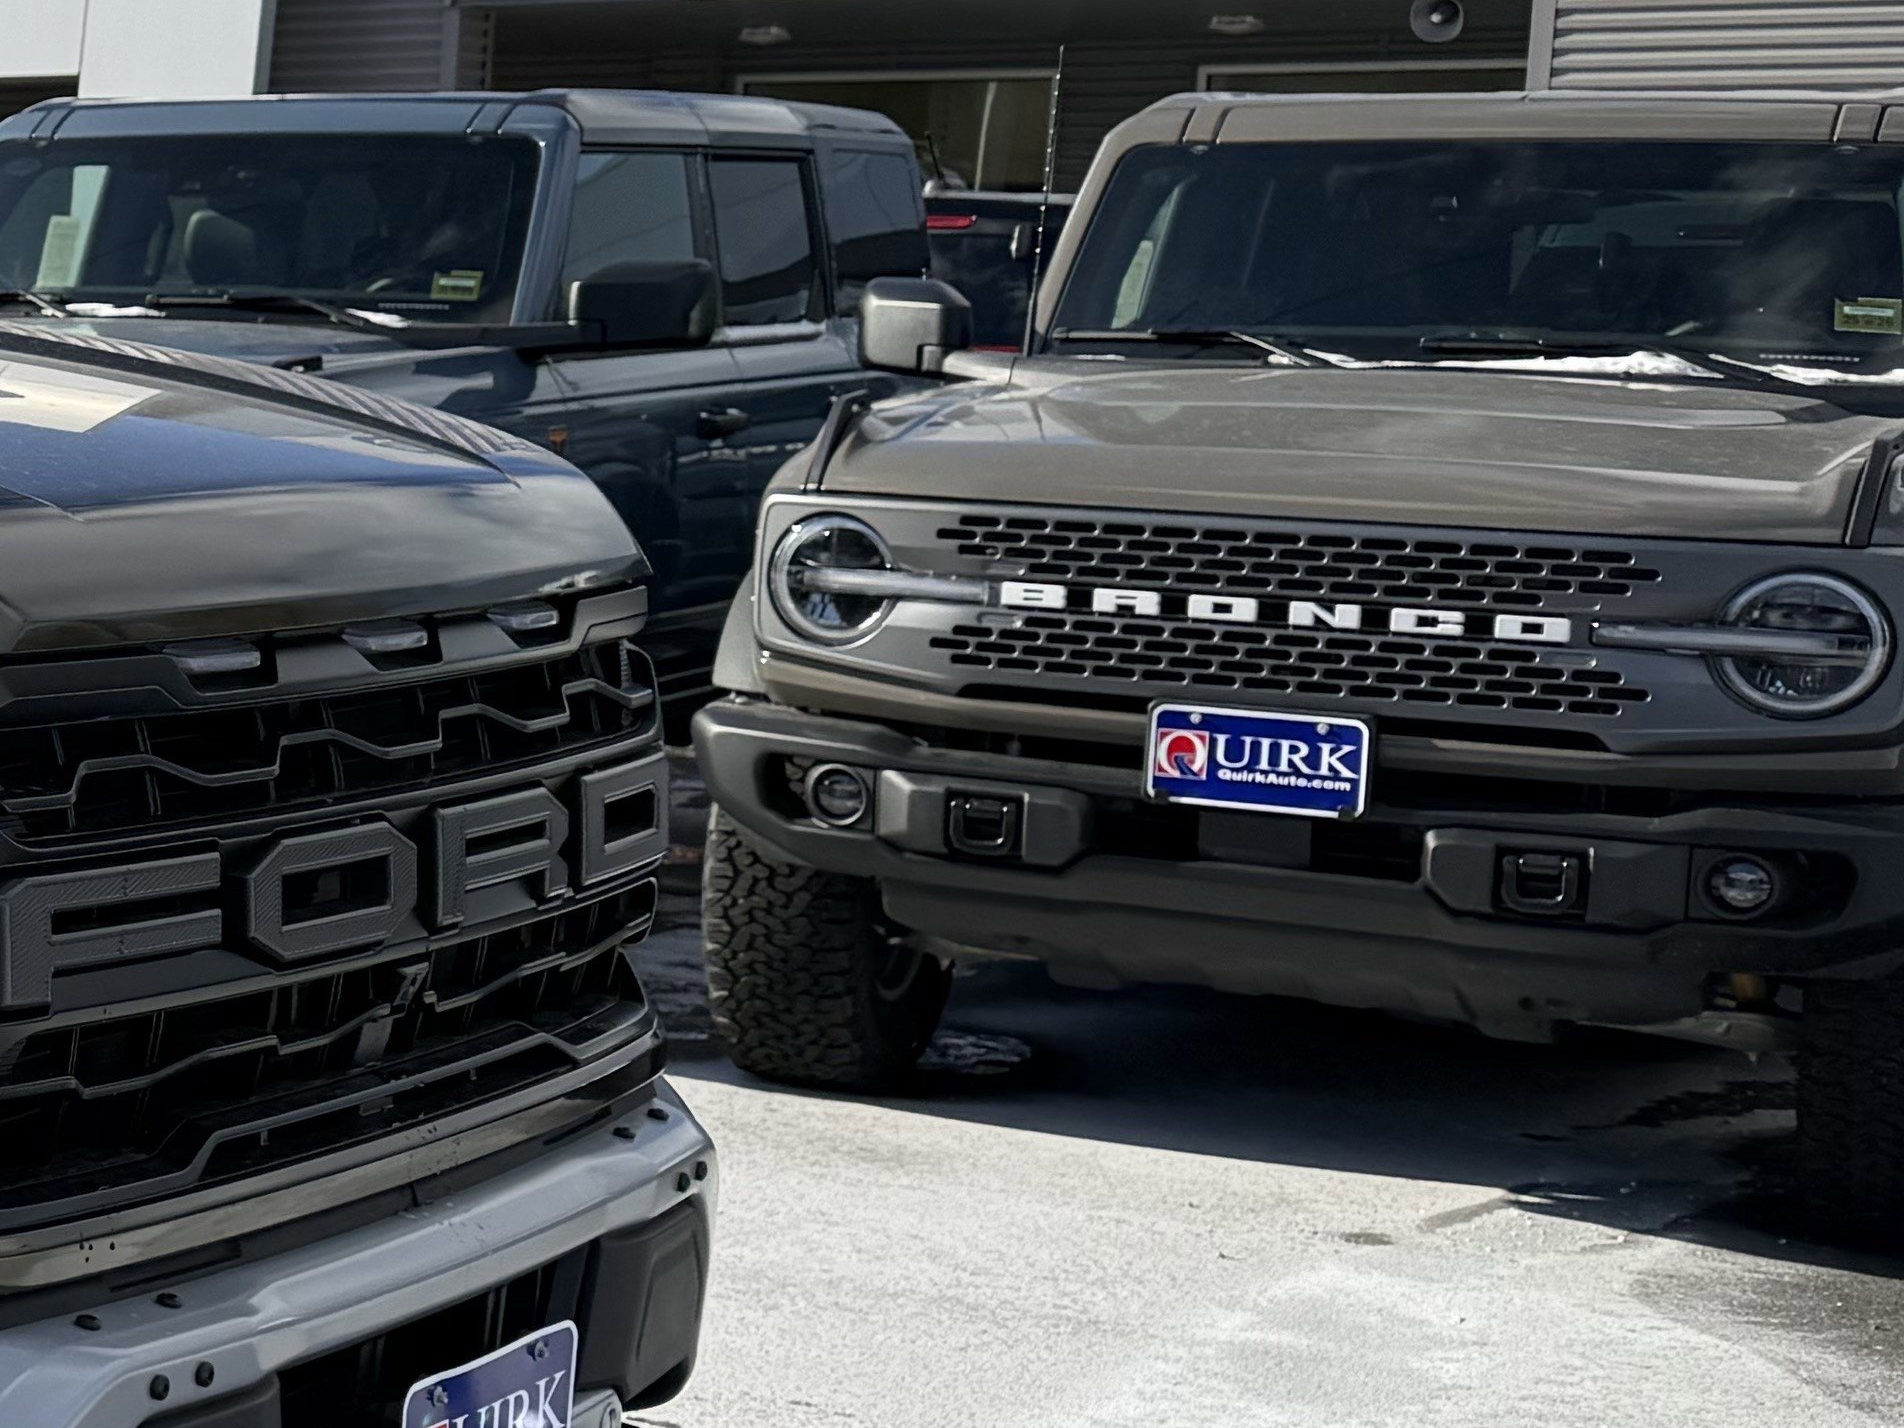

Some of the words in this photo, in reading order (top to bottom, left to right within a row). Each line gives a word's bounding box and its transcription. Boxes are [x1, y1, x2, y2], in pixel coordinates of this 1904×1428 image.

[1000, 580, 1570, 643] BRONCO
[1156, 728, 1359, 780] QUIRK
[1217, 768, 1352, 792] QuirkAuto.com
